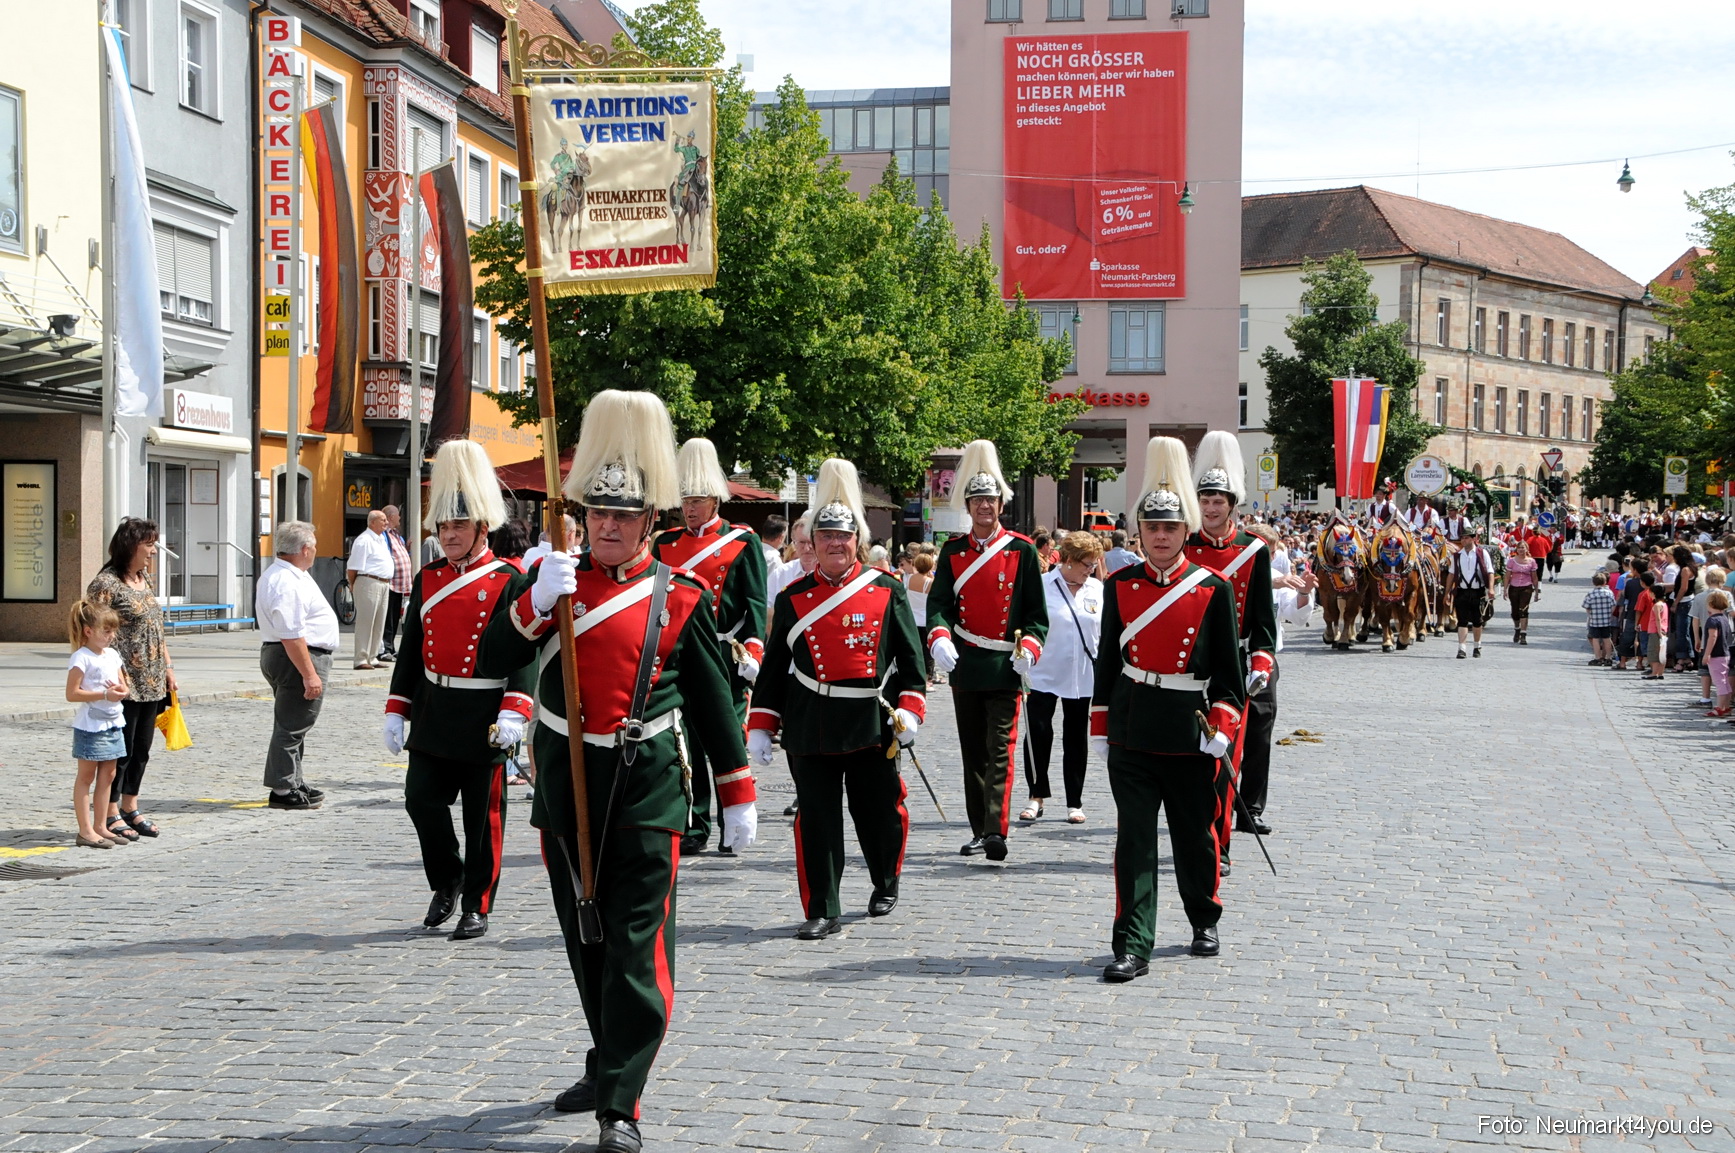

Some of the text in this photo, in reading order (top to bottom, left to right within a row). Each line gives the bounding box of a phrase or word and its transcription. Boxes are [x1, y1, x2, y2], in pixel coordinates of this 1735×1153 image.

[1016, 42, 1083, 51] Wir hätten es
[1017, 51, 1145, 69] NOCH GRÖSSER
[1016, 68, 1175, 82] machen können, aber wir haben
[1017, 84, 1127, 100] LIEBER MEHR
[551, 95, 698, 119] TRADITIONS-
[1016, 102, 1107, 114] in dieses Angebot
[1016, 116, 1062, 128] gesteckt:
[579, 121, 667, 143] VEREIN
[268, 20, 291, 285] BÄCKEREI
[586, 189, 668, 205] NEUMARKTER
[1118, 186, 1148, 194] Volksfest-
[1099, 197, 1134, 206] Schmankerl
[589, 206, 668, 222] CHEVAULEGERS
[1102, 207, 1114, 224] 6
[1138, 210, 1151, 218] und
[1100, 221, 1153, 236] Getränkemarke
[569, 244, 689, 271] ESKADRON
[1015, 244, 1067, 255] Gut, oder?
[1100, 262, 1140, 272] Sparkasse
[1101, 272, 1176, 282] Neumarkt-Parsberg
[176, 392, 231, 430] Brezenhaus
[348, 484, 372, 508] Café
[30, 503, 43, 587] service
